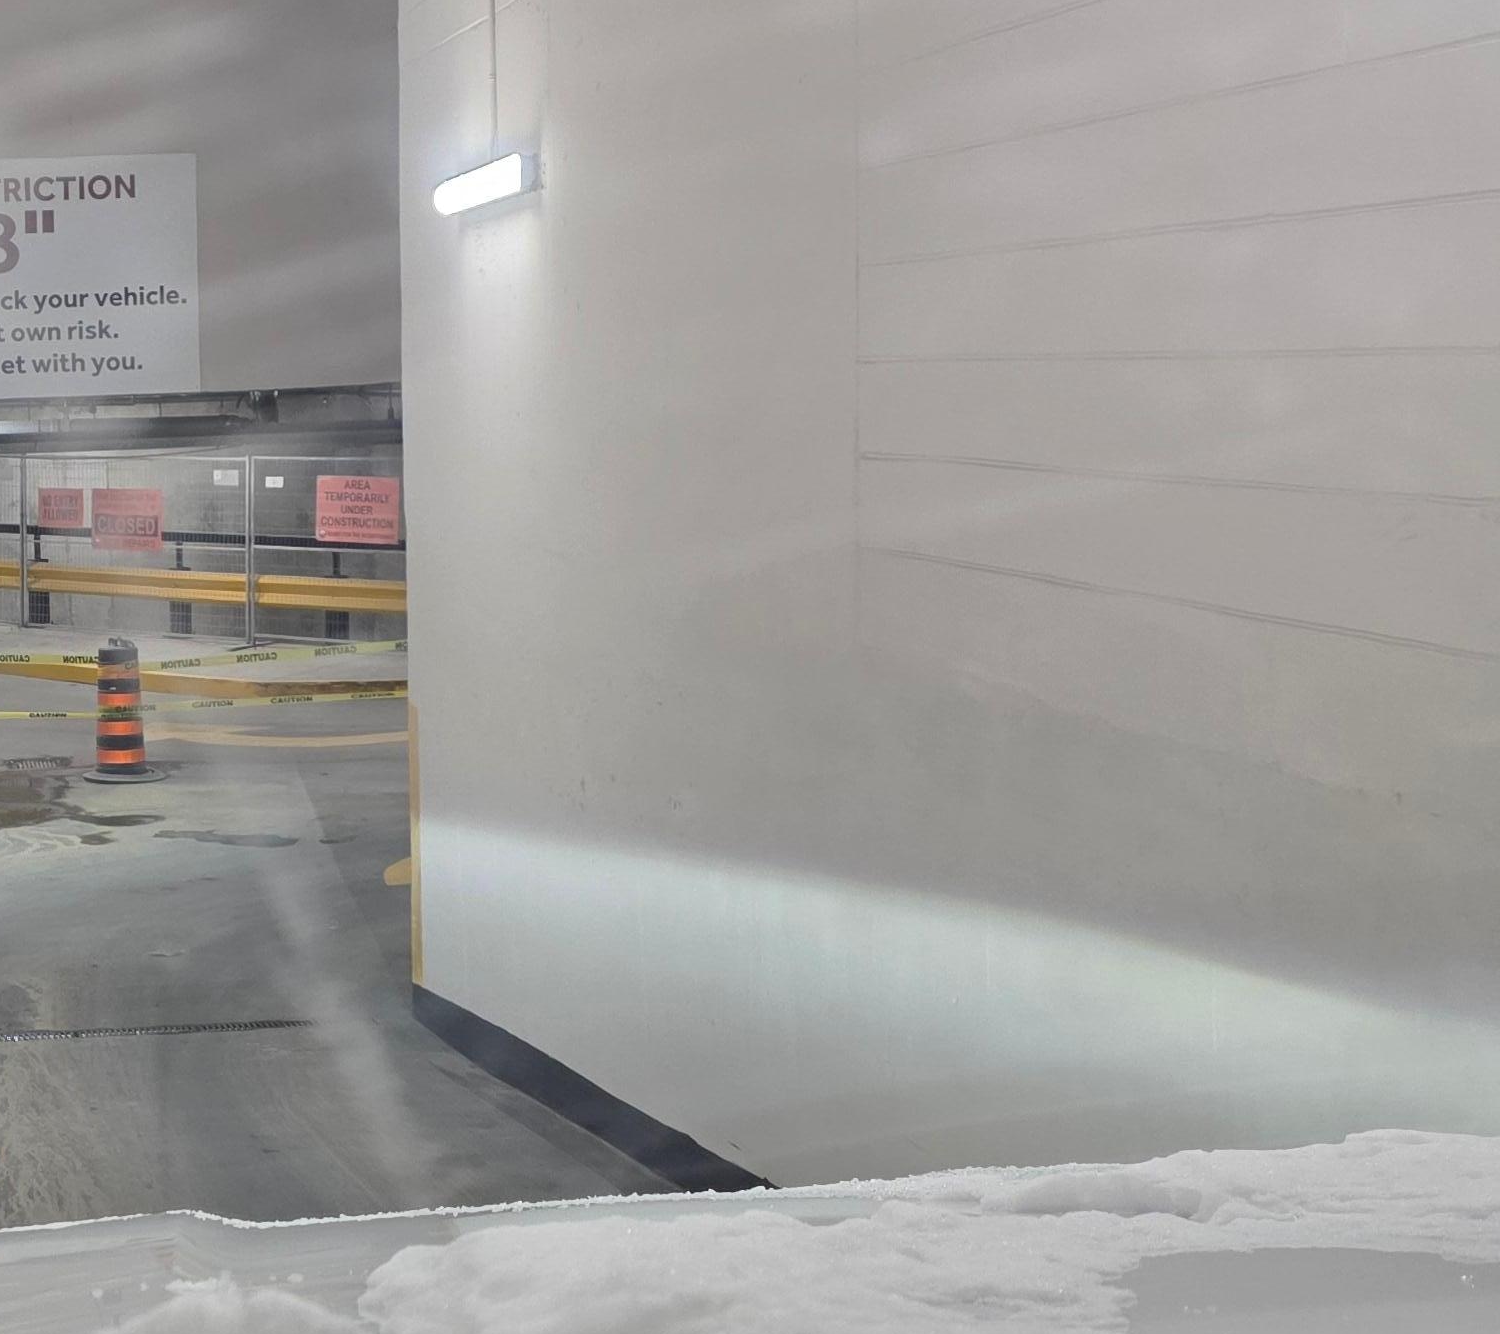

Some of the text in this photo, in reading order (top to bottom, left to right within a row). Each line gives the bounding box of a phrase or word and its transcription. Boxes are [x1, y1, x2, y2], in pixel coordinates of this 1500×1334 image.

[33, 292, 89, 314] your
[94, 285, 188, 307] vehicle.
[11, 325, 61, 342] own
[67, 319, 119, 340] risk.
[32, 352, 85, 373] with
[92, 355, 143, 377] you.
[344, 479, 371, 490] AREA
[324, 491, 391, 504] TEMPORARILY
[341, 505, 373, 515] UNDER
[97, 516, 156, 535] CLOSED
[321, 516, 394, 529] CONSTRUCTION
[192, 699, 233, 708] CAUTION
[270, 696, 313, 705] CAUTION
